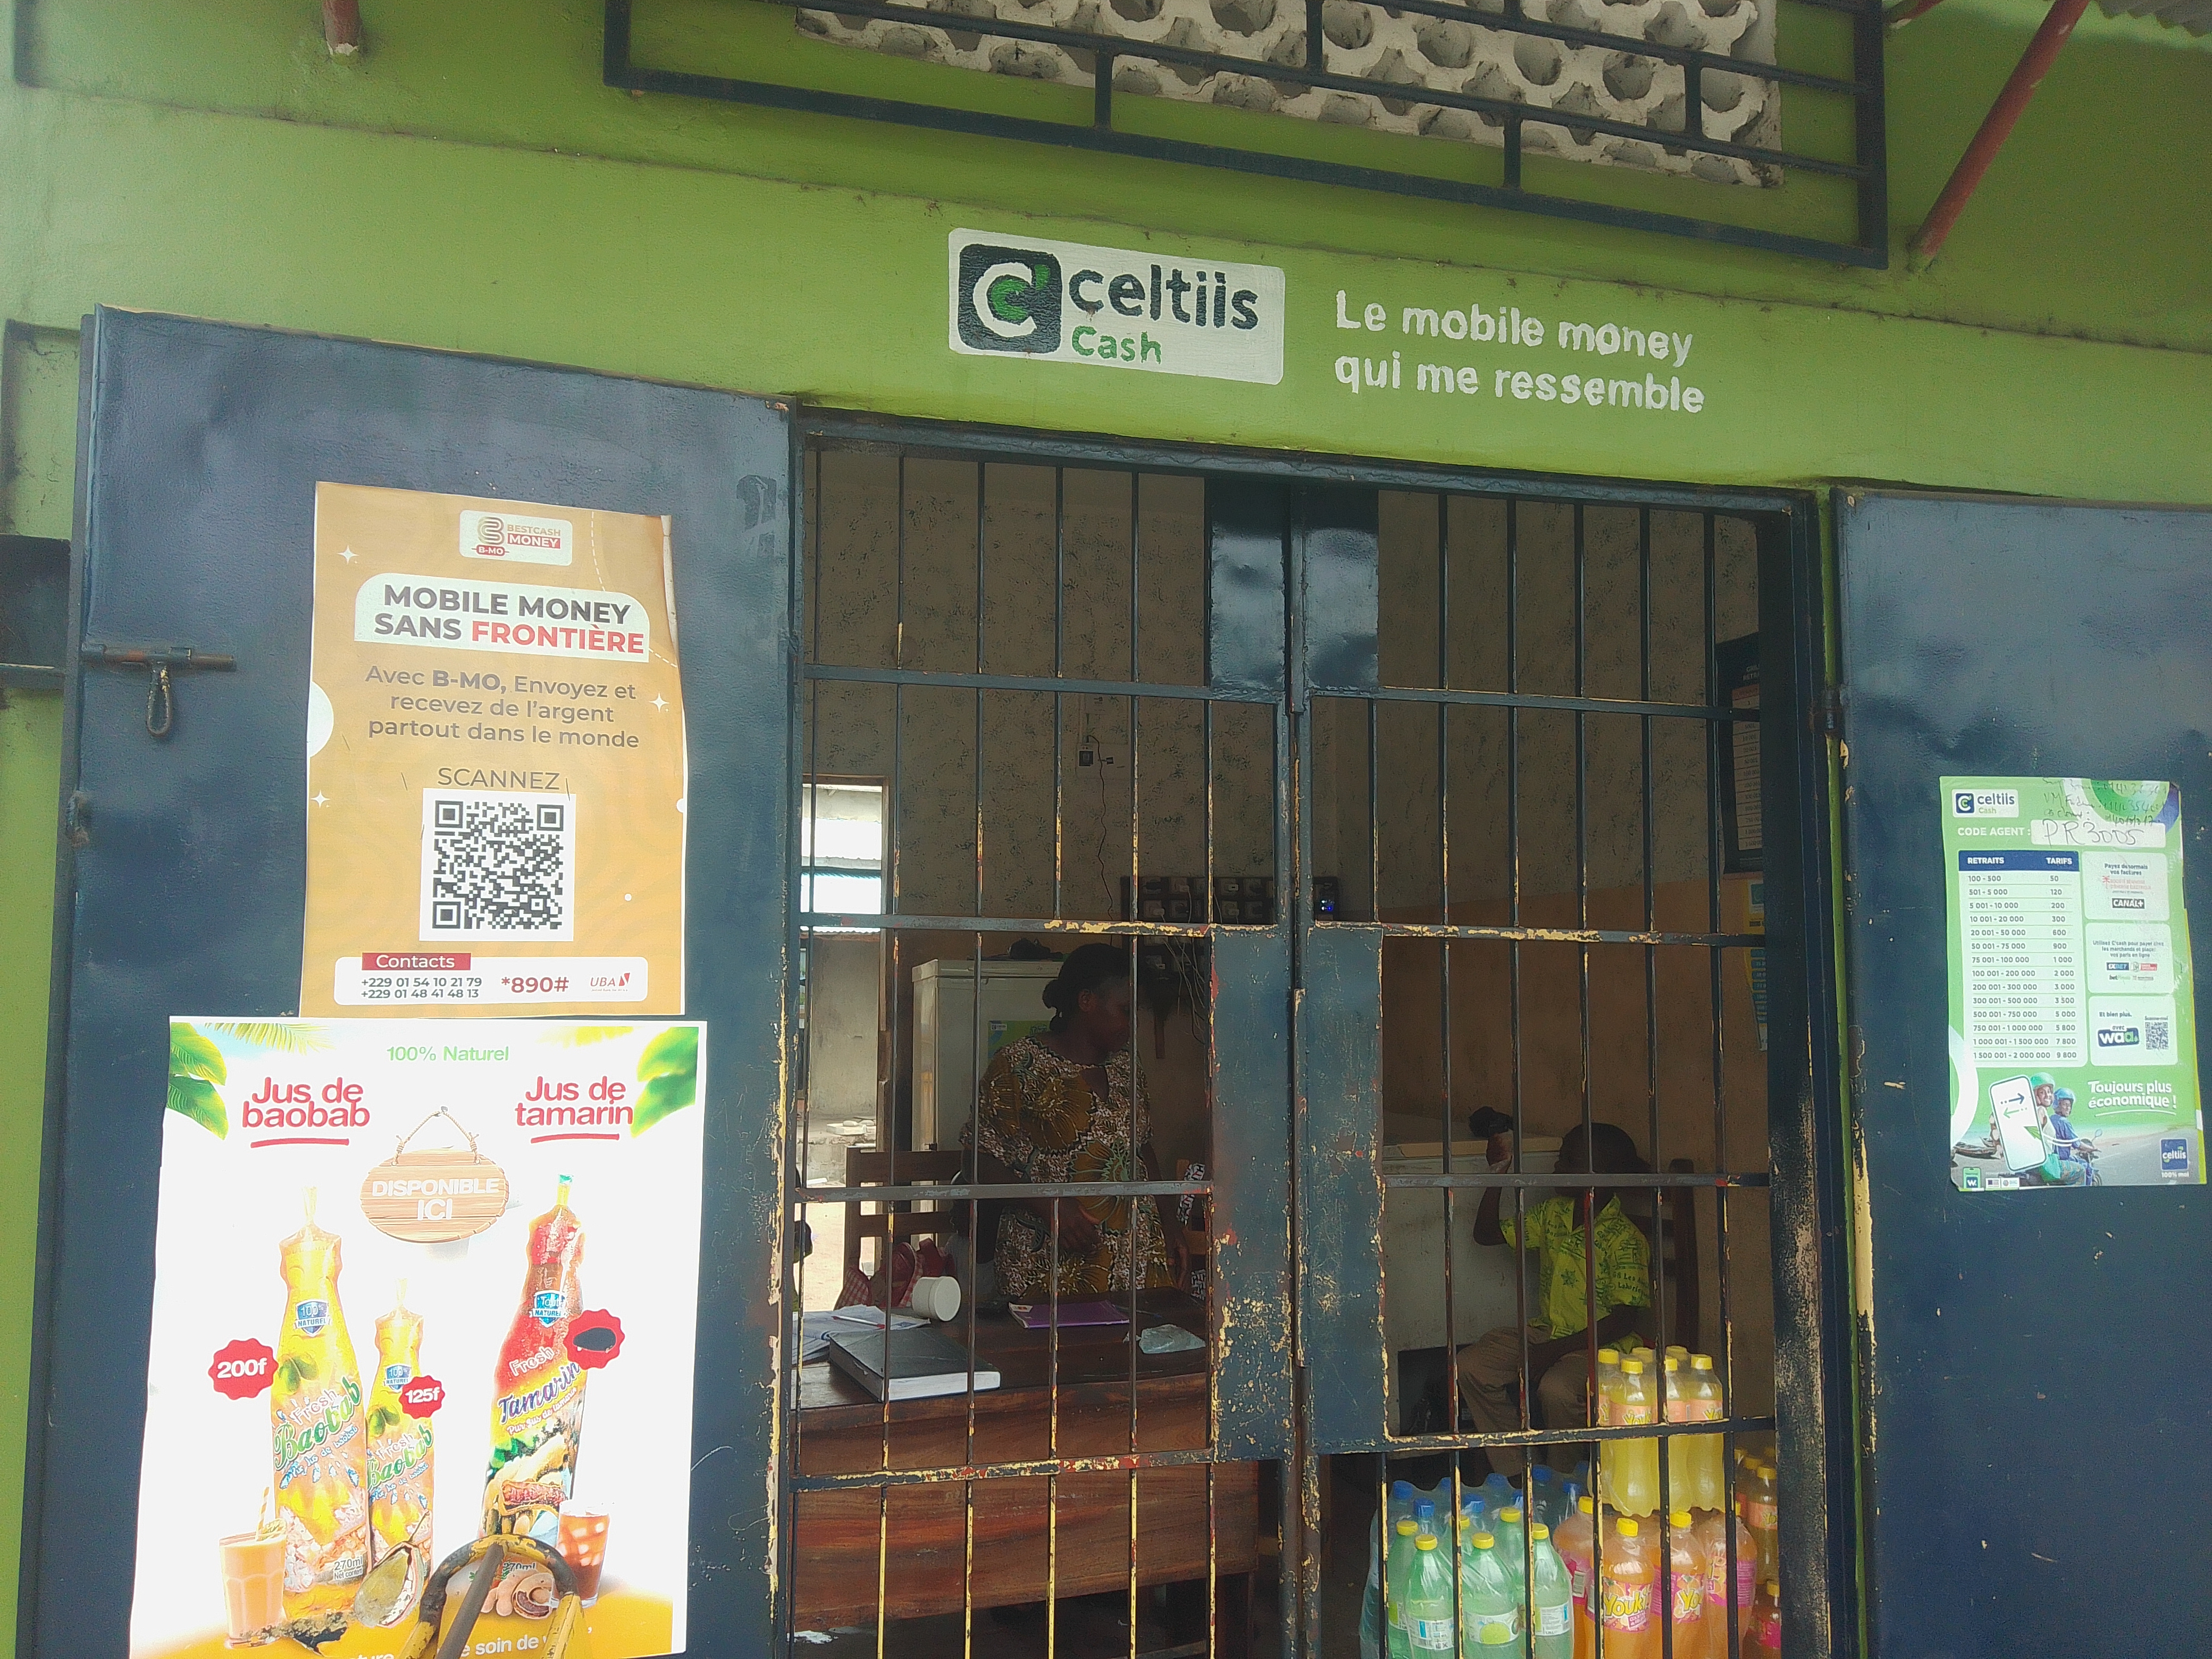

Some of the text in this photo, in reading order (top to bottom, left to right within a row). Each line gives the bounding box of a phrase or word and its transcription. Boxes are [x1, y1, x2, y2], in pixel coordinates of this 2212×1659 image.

[1068, 264, 1259, 330] celtiis
[1334, 290, 1693, 368] Le mobile money
[1071, 325, 1161, 364] Cash
[1335, 350, 1705, 413] qui me ressemble
[507, 524, 561, 537] BESTCASH
[509, 534, 558, 548] MONEY
[479, 546, 504, 555] B-MO
[384, 584, 631, 625] MOBILE MONEY
[374, 613, 644, 654] SANS FRONTIÈRE
[365, 665, 636, 700] Avec B-MO, Envoyez et
[390, 695, 615, 724] recevez de l'argent
[368, 719, 640, 748] partout dans le monde
[437, 767, 561, 791] SCANNEZ
[1977, 792, 2015, 805] celtiis
[1957, 827, 1987, 836] CODE
[1989, 827, 2025, 836] AGENT
[2113, 899, 2143, 908] CANAL+
[376, 954, 455, 969] Contacts
[361, 977, 482, 987] +229 01 54 10 21 79
[590, 977, 616, 987] UBA
[361, 989, 479, 999] +229 01 48 41 48 13
[387, 1046, 509, 1061] 100% Naturel
[252, 1076, 364, 1104] Jus de
[525, 1075, 626, 1101] Jus de
[2088, 1080, 2172, 1094] Toujours plus
[2088, 1093, 2170, 1109] économique
[242, 1101, 371, 1128] baobab
[515, 1099, 634, 1126] tamarin
[372, 1178, 500, 1196] DISPONIBLE
[417, 1198, 454, 1221] ICI
[298, 1318, 326, 1327] NATUREL
[217, 1358, 267, 1378] 200f
[508, 1346, 556, 1377] Fresh
[405, 1387, 440, 1404] 125f
[498, 1362, 581, 1425] Tamarin
[334, 1555, 363, 1571] 270ml
[475, 1639, 513, 1657] soin
[516, 1634, 539, 1650] de
